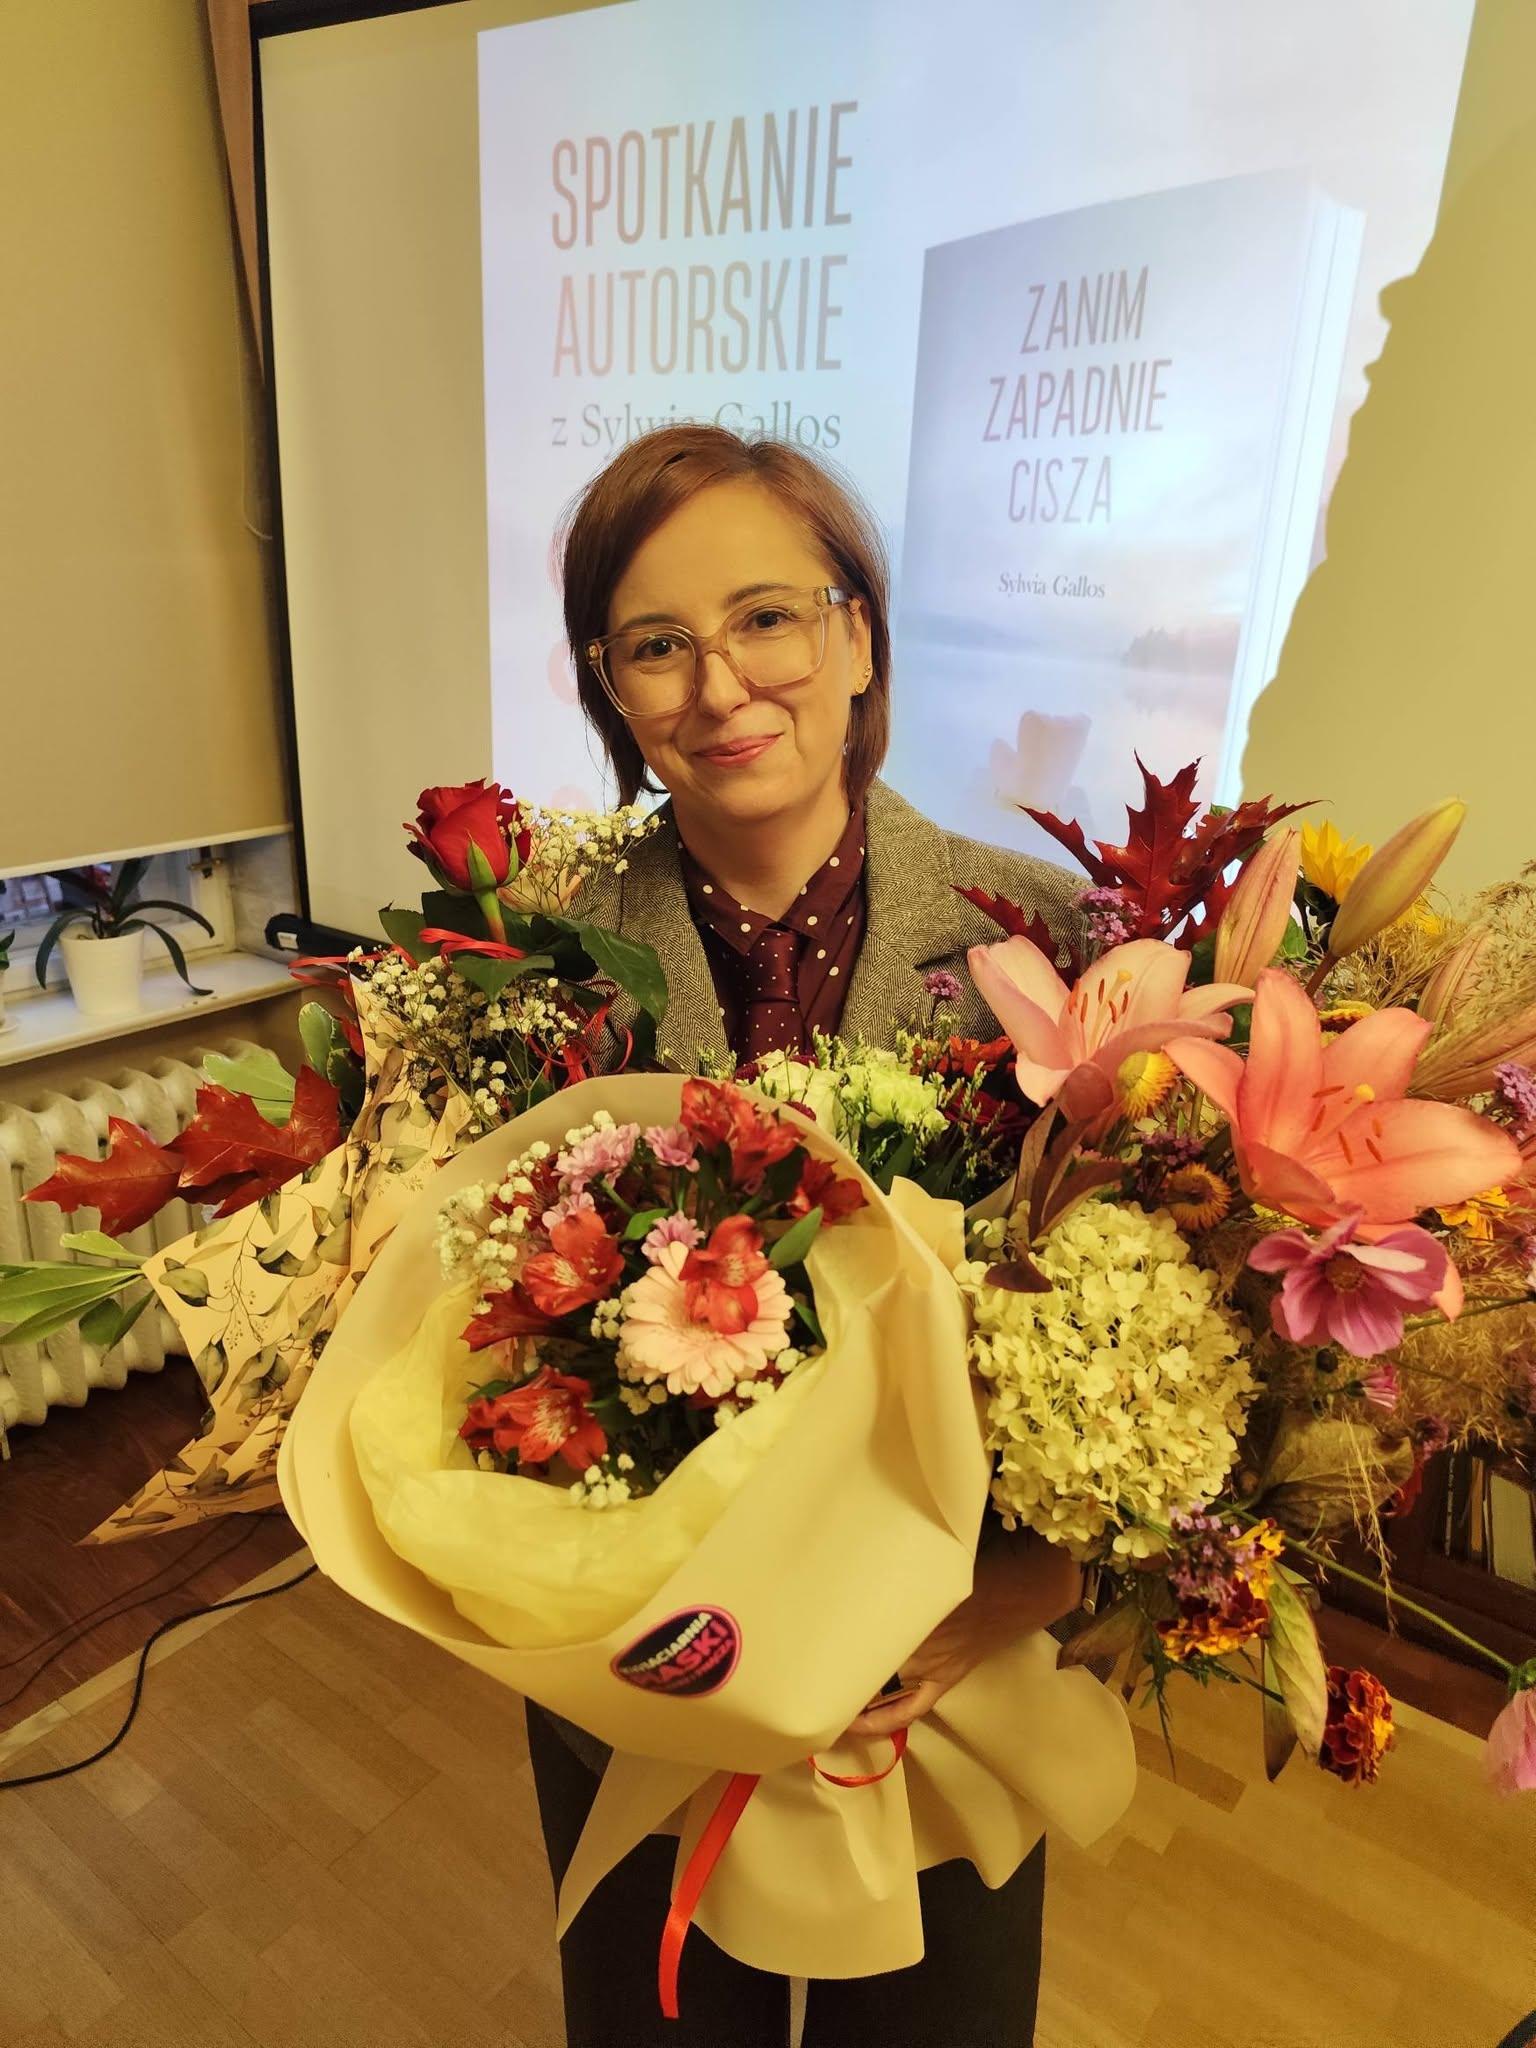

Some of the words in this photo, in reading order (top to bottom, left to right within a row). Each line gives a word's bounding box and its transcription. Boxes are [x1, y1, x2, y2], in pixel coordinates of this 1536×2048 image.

[552, 100, 859, 251] SPOTKANIE
[552, 254, 848, 378] AUTORSKIE
[1020, 265, 1149, 354] ZANIM
[551, 416, 568, 447] z
[982, 359, 1172, 442] ZAPADNIE
[1008, 455, 1111, 524] CISZA
[998, 572, 1047, 598] Sylwia
[1052, 573, 1106, 598] Gallos
